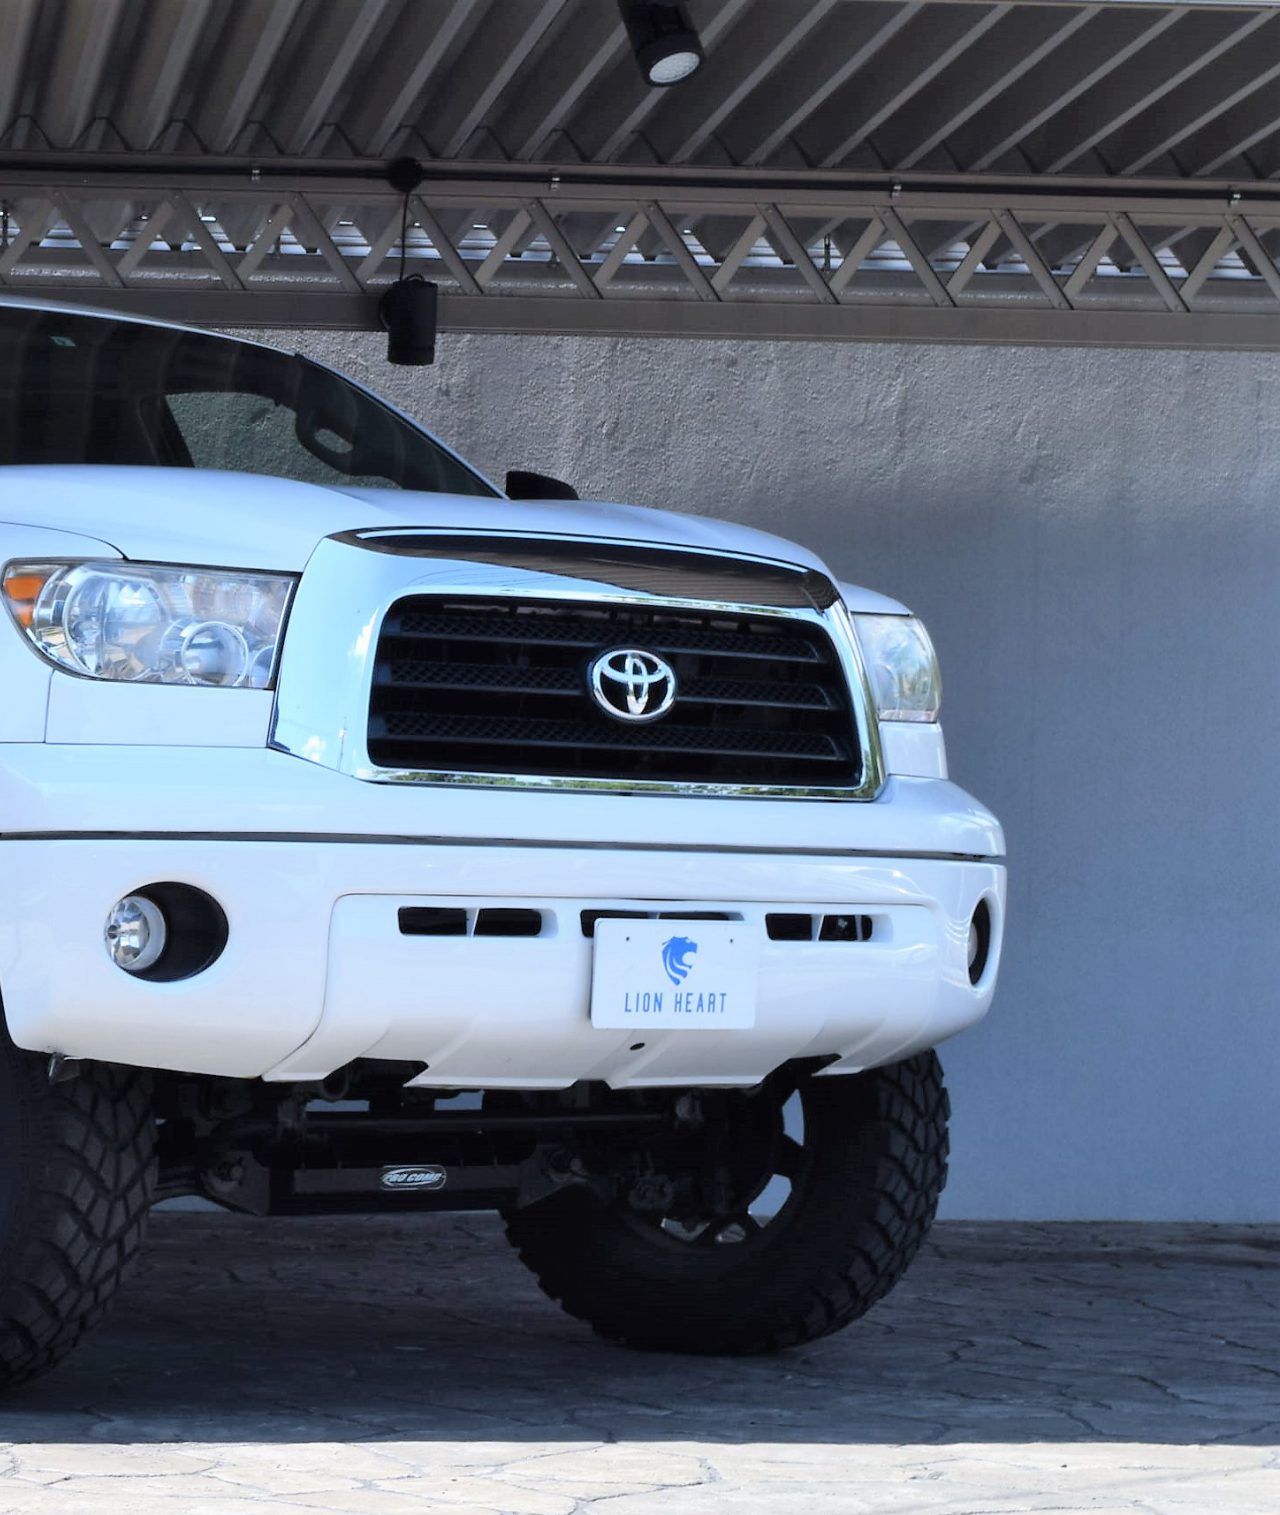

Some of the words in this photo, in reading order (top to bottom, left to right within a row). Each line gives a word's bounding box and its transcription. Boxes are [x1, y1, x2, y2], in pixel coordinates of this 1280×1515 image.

[624, 992, 663, 1013] LION
[674, 992, 727, 1014] HEART
[406, 1173, 442, 1182] COMP
